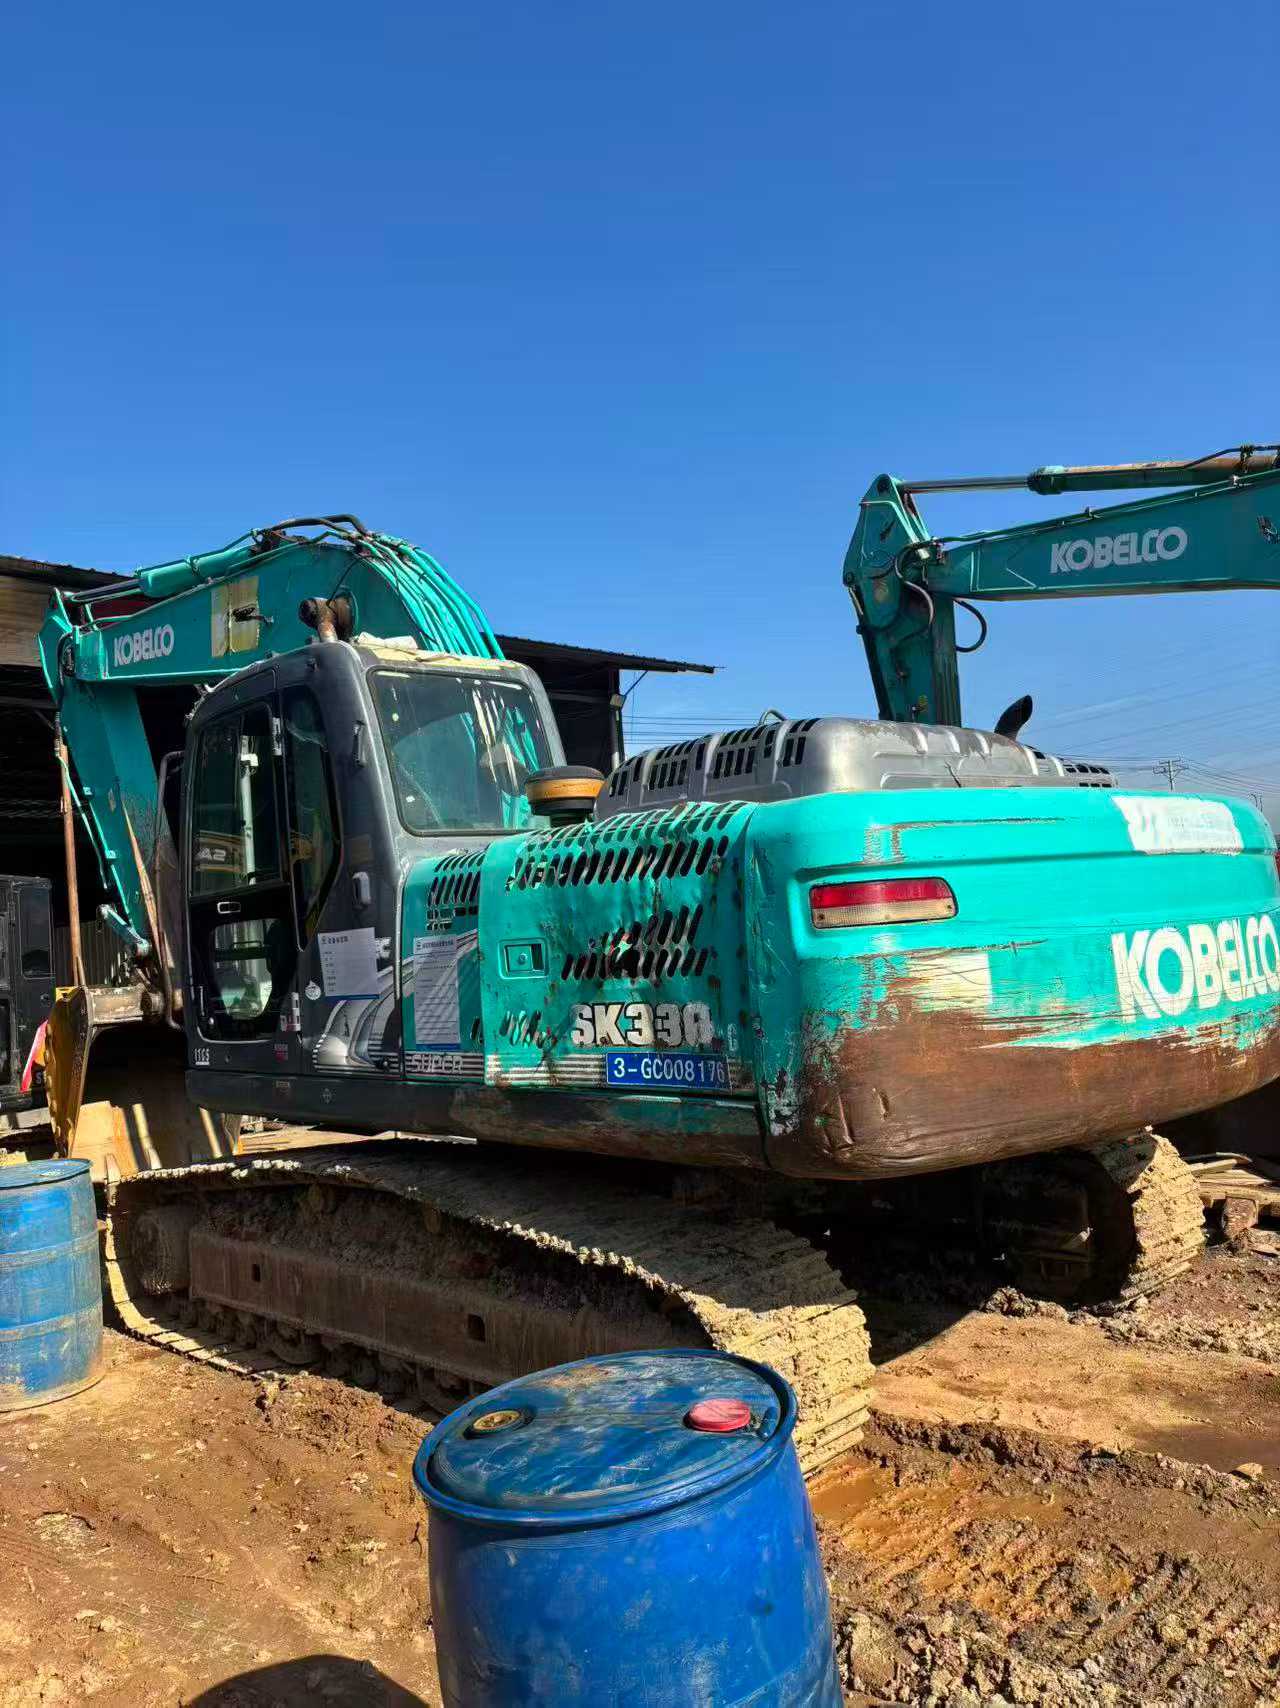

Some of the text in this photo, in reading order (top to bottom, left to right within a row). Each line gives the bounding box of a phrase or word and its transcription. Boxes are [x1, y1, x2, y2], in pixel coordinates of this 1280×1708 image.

[1050, 526, 1188, 574] KOBELCO
[114, 624, 175, 668] KOBELCO
[1111, 914, 1280, 1024] KOBELCO
[411, 1054, 463, 1074] SUPER
[613, 1057, 725, 1083] 3-GC008176
